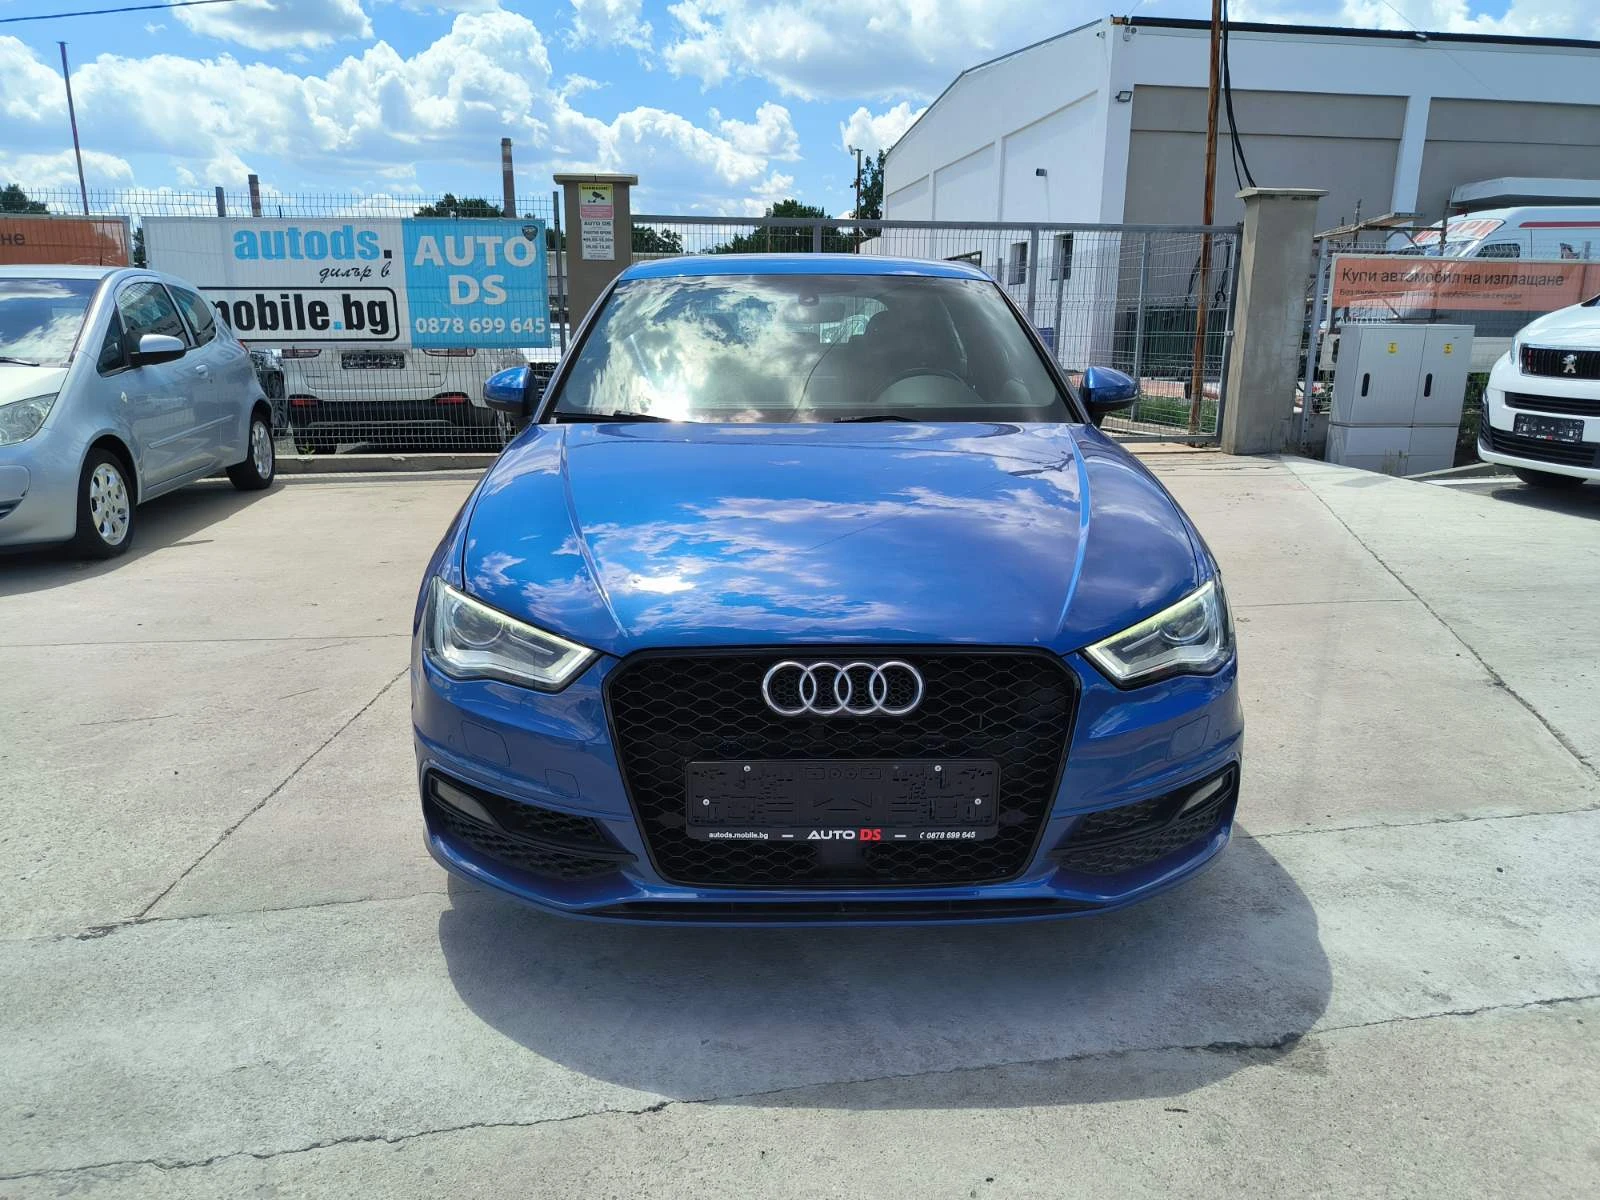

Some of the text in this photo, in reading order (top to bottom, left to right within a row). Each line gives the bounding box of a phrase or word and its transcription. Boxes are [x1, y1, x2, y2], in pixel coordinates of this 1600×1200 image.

[233, 224, 392, 260] autods.
[413, 235, 536, 267] AUTO
[319, 261, 391, 283] дилър в
[1342, 267, 1565, 287] Купи автомобил на изплащане
[449, 274, 508, 305] DS
[415, 317, 546, 333] 0878 699 645
[708, 832, 769, 840] autods.mobile.bg
[807, 830, 856, 840] AUTO
[859, 828, 881, 841] DS
[961, 831, 976, 839] 645
